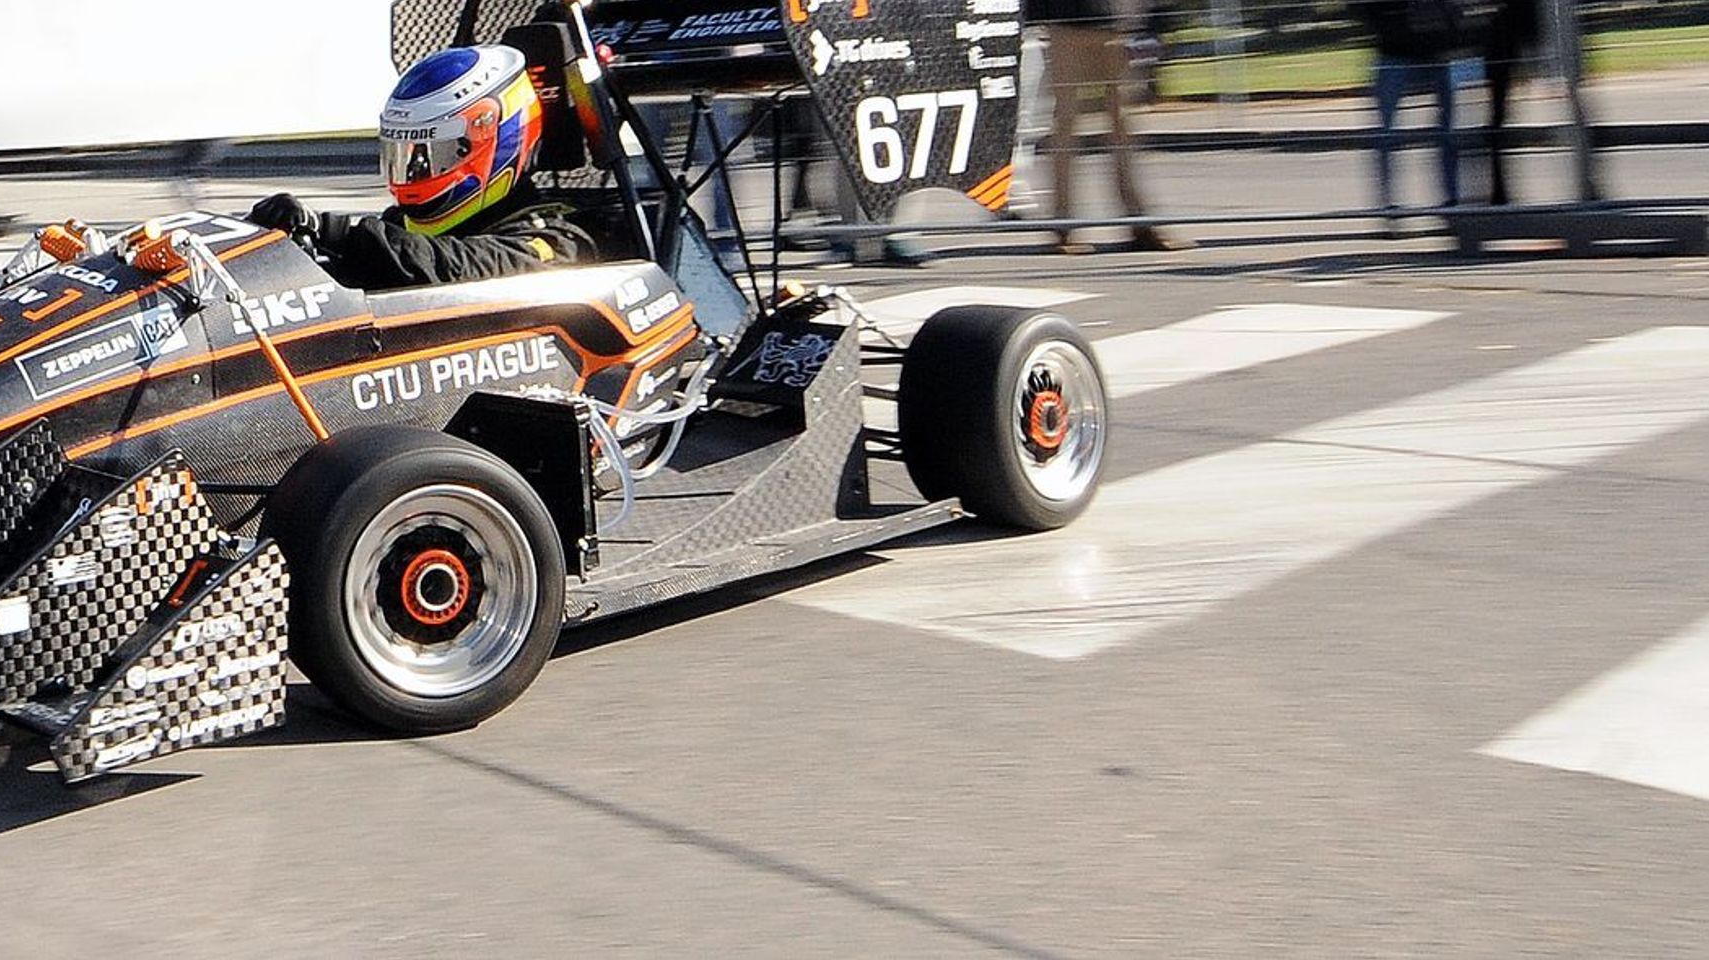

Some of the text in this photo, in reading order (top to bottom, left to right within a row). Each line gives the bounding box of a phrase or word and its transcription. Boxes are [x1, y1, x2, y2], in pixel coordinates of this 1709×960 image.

[668, 19, 783, 40] ENGINEER
[680, 7, 778, 27] FACULTY
[855, 89, 979, 184] 677
[42, 333, 136, 379] ZEPPELIN
[351, 335, 560, 411] CTU PRAGUE
